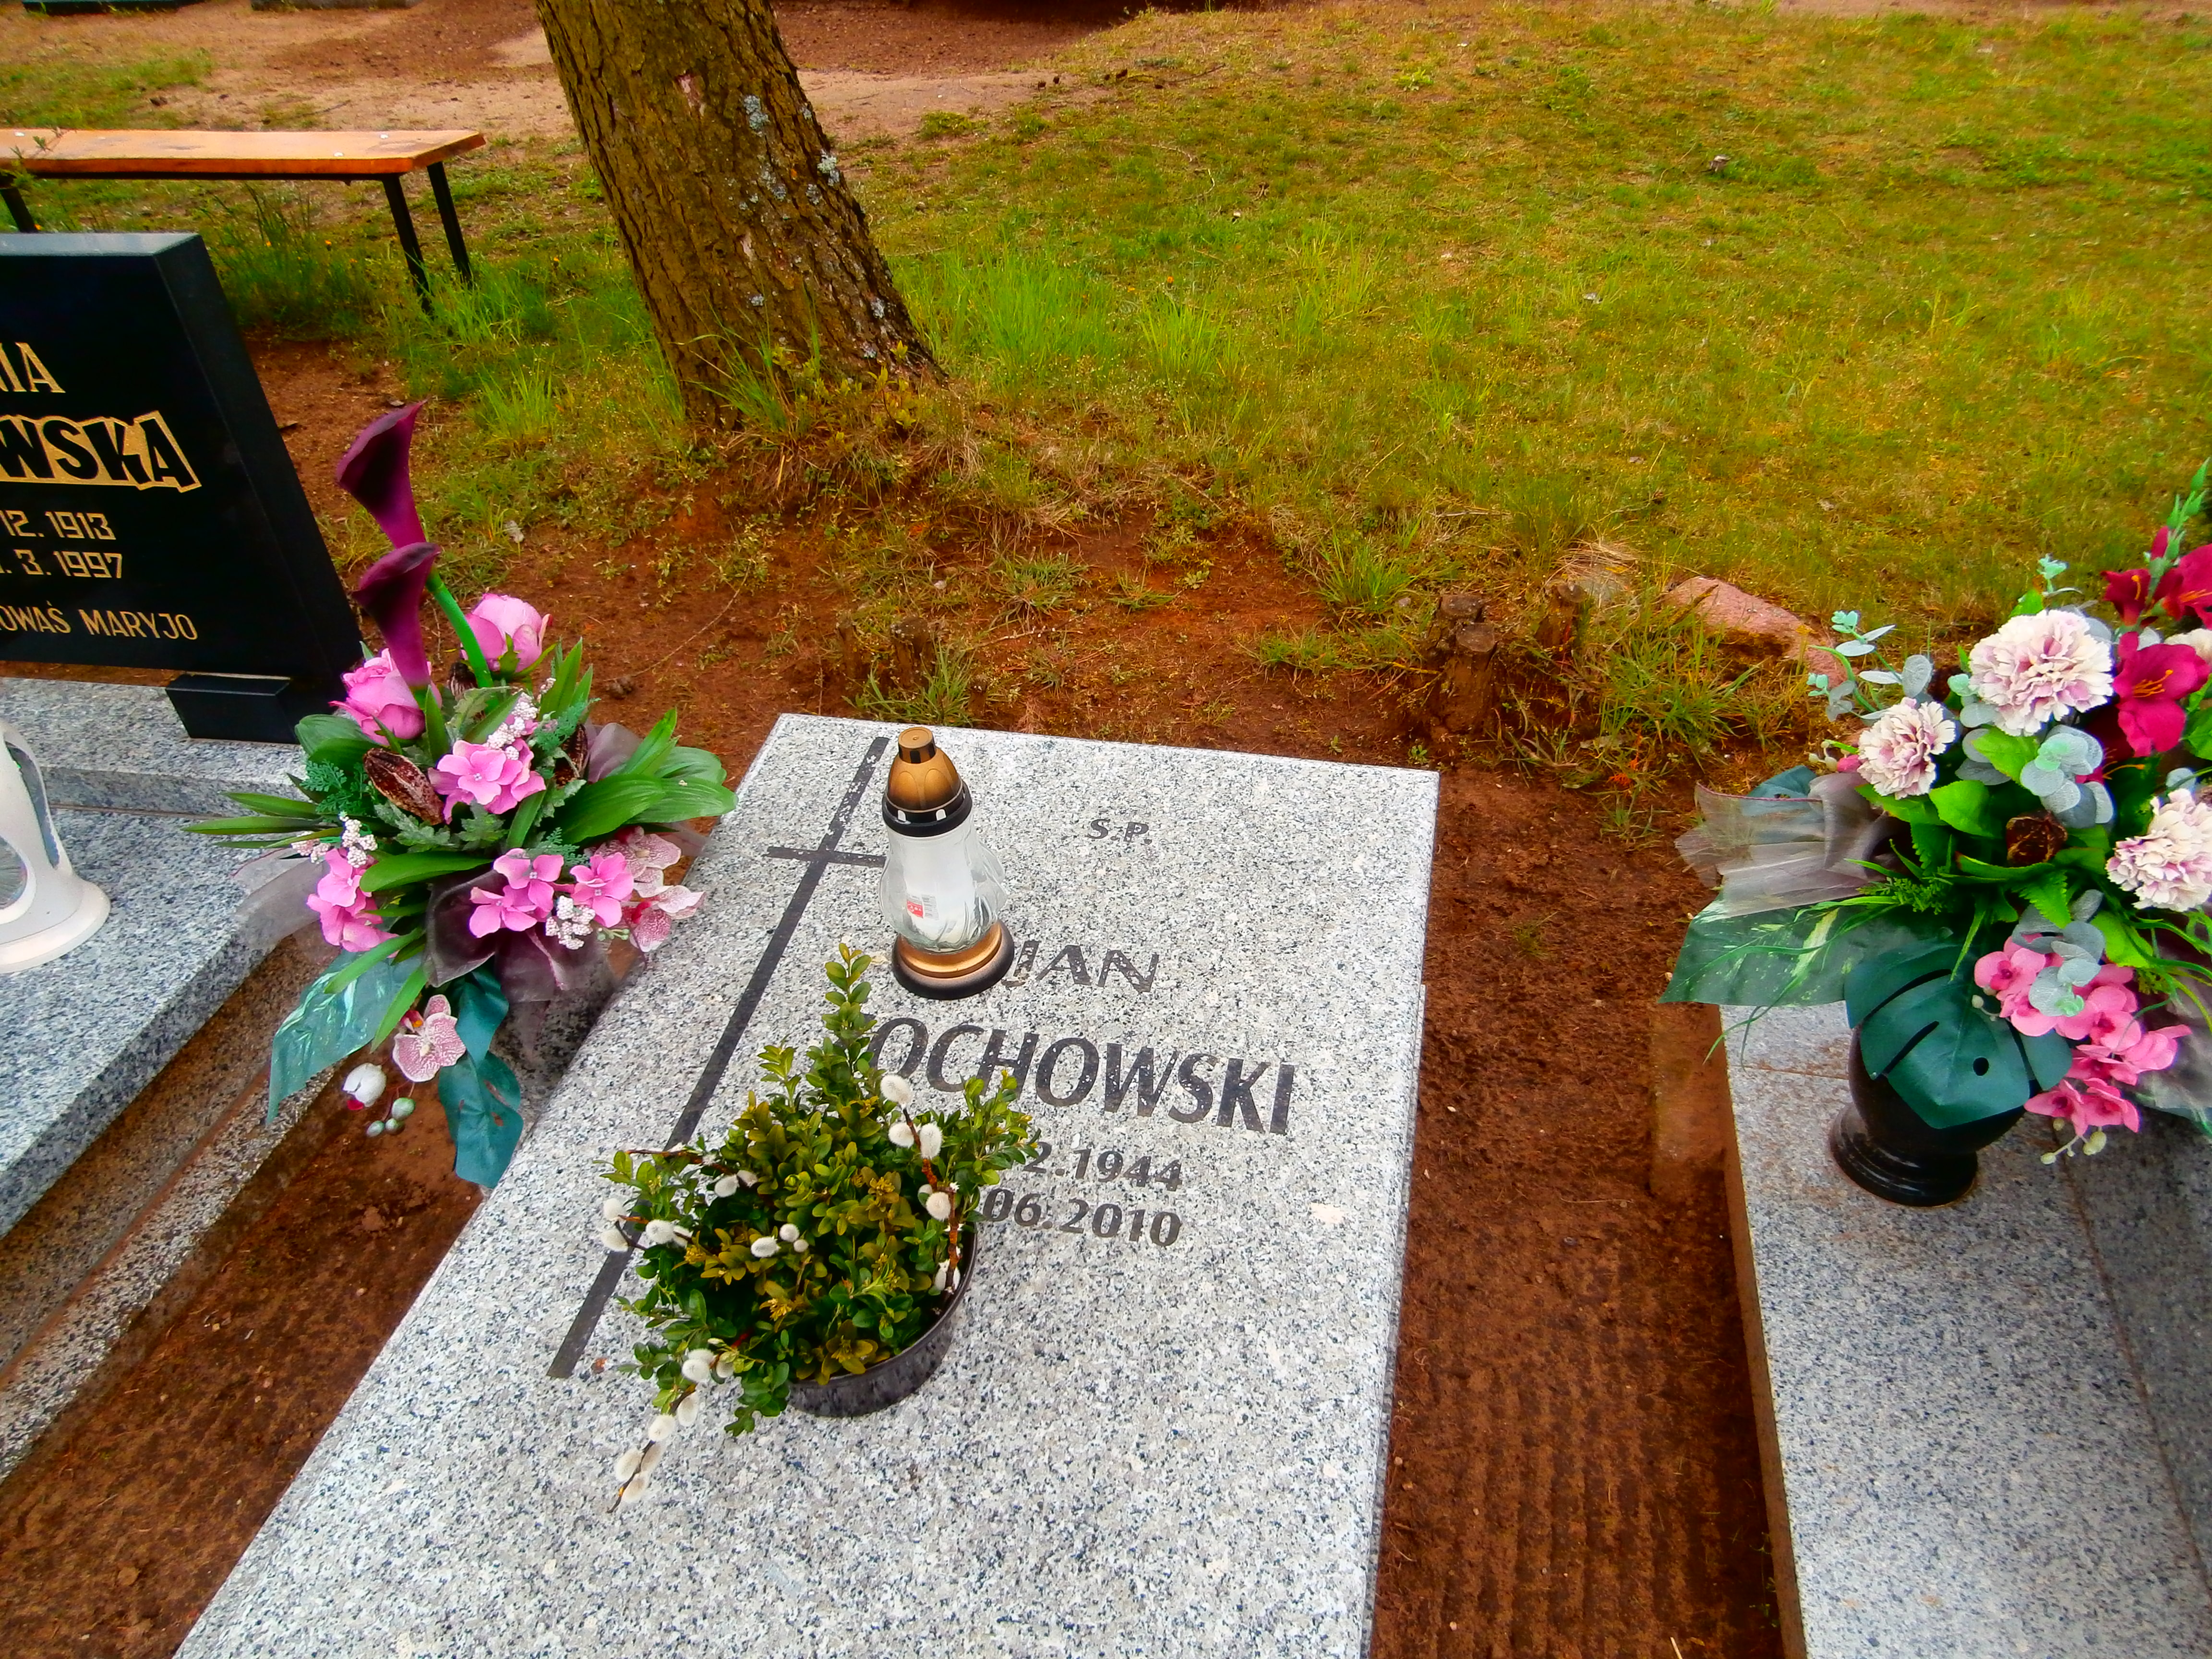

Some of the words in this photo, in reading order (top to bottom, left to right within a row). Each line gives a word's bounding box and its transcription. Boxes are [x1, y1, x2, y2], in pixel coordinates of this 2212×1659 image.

[45, 511, 116, 540] 1913
[53, 551, 122, 579] 1997
[0, 600, 71, 634] OWAŚ
[78, 609, 198, 640] MARYJO
[1001, 939, 1159, 994] JAN
[834, 1013, 1295, 1135] OCHOWSKI
